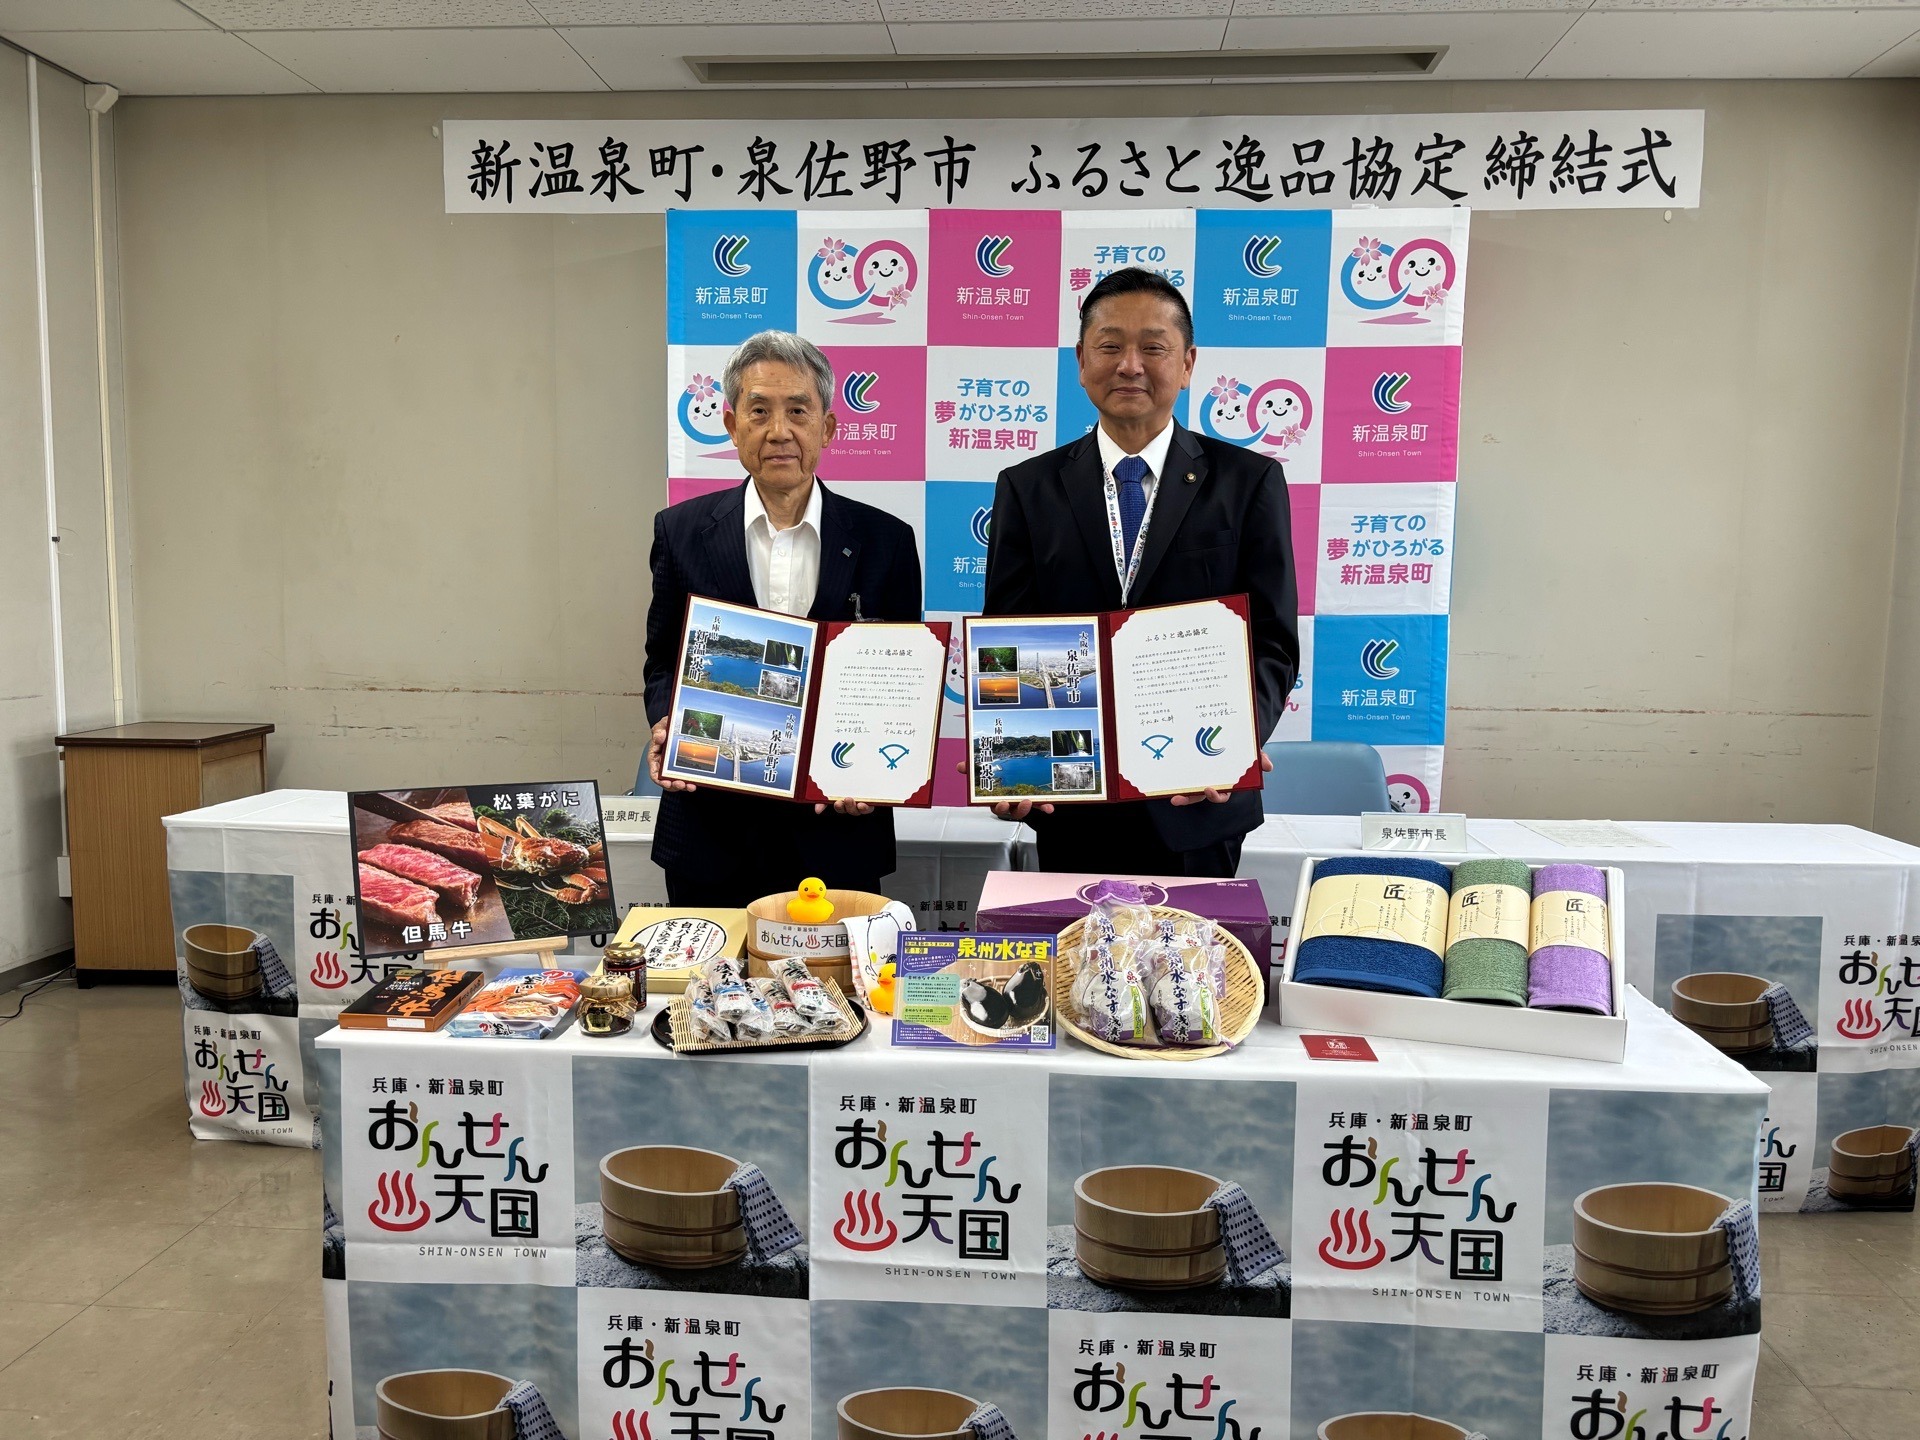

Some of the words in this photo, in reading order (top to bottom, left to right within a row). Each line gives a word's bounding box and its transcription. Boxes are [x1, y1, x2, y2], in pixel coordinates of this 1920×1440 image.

[467, 135, 976, 204] 新温泉町・泉佐野市
[1094, 245, 1166, 264] 子育ての
[695, 287, 768, 306] 新温泉町
[956, 287, 1031, 306] 新温泉町
[1223, 287, 1299, 307] 新温泉町
[701, 312, 742, 320] Shin-Onsen
[745, 312, 763, 320] Town
[962, 313, 1003, 321] Shin-Onsen
[1006, 313, 1024, 321] Town
[957, 379, 1030, 398] 子育ての
[935, 400, 1048, 424] 夢がひろがる
[949, 428, 1038, 451] 新温泉町
[1352, 423, 1428, 443] 新温泉町
[1351, 514, 1426, 533] 子育ての
[1327, 537, 1444, 560] 夢がひろがる
[953, 556, 987, 574] 新温
[1340, 563, 1433, 586] 新温泉町
[1079, 631, 1089, 657] 大阪府
[688, 629, 709, 684] 新温泉町
[1066, 650, 1082, 704] 泉佐野市
[1341, 688, 1417, 708] 新温泉町
[784, 713, 797, 740] 大阪府
[1347, 713, 1389, 721] Shin-Onsen
[1391, 713, 1411, 721] Town
[763, 729, 783, 783] 泉佐野市
[979, 736, 996, 792] 新温泉町
[493, 790, 580, 811] 松葉がに
[601, 810, 652, 823] 温泉町長
[1381, 827, 1448, 842] 泉佐野市長
[1383, 884, 1406, 900] 匠
[1461, 891, 1480, 908] 匠
[1566, 898, 1586, 914] 匠
[401, 921, 473, 944] 但馬牛
[957, 937, 1052, 960] 泉州水なす
[1882, 998, 1920, 1037] 天
[372, 1077, 504, 1097] 兵庫・新温泉町
[839, 1095, 977, 1115] 兵庫・新温泉町
[1328, 1111, 1473, 1132] 兵庫・新温泉町
[368, 1099, 549, 1184] おんせん
[835, 1118, 1022, 1204] おんせん
[1322, 1134, 1517, 1224] おんせん
[434, 1174, 539, 1239] 天国
[902, 1194, 1009, 1261] 天国
[418, 1246, 503, 1258] SHIN-ONSEN
[514, 1247, 548, 1259] TOWN
[1390, 1212, 1504, 1281] 天国
[885, 1267, 971, 1279] SHIN-ONSEN
[982, 1271, 1017, 1281] TOWN
[1372, 1287, 1463, 1301] SHIN-ONSEN
[1474, 1291, 1511, 1302] TOWN
[607, 1314, 741, 1336] 兵庫・新温泉町
[1078, 1339, 1217, 1359] 兵庫・新温泉町
[603, 1337, 786, 1424] おんせん
[1577, 1364, 1720, 1384] 兵庫・新温泉町
[1073, 1362, 1262, 1440] おんせん
